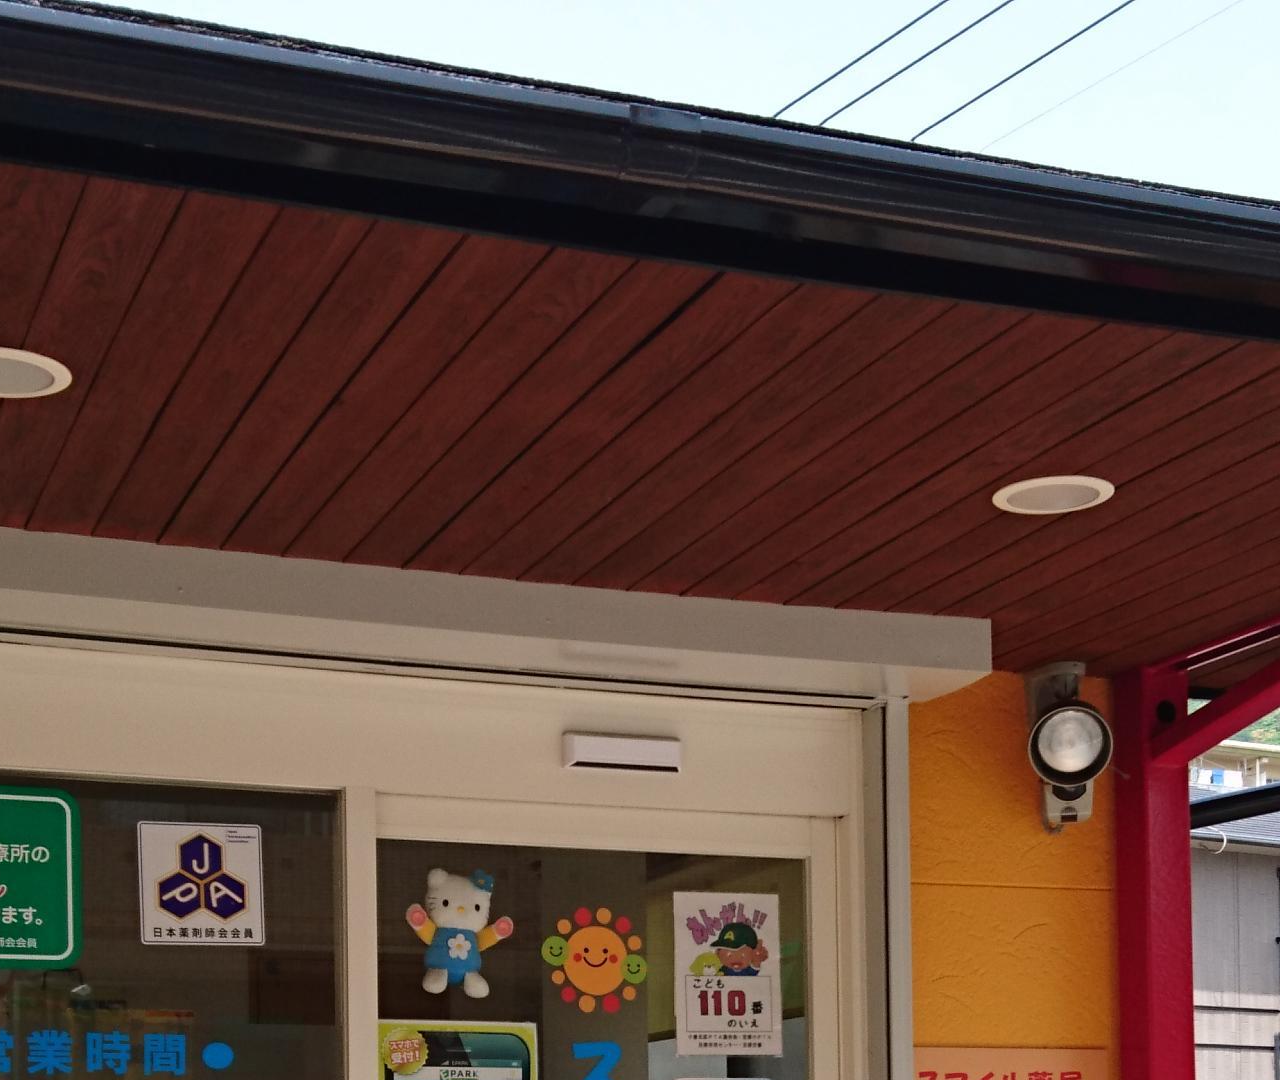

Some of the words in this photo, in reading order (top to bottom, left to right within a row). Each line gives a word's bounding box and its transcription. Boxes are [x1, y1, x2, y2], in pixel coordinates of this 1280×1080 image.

[153, 927, 254, 939] 日本薬剤師会会員
[693, 978, 725, 989] こども
[727, 1018, 759, 1029] のいえ
